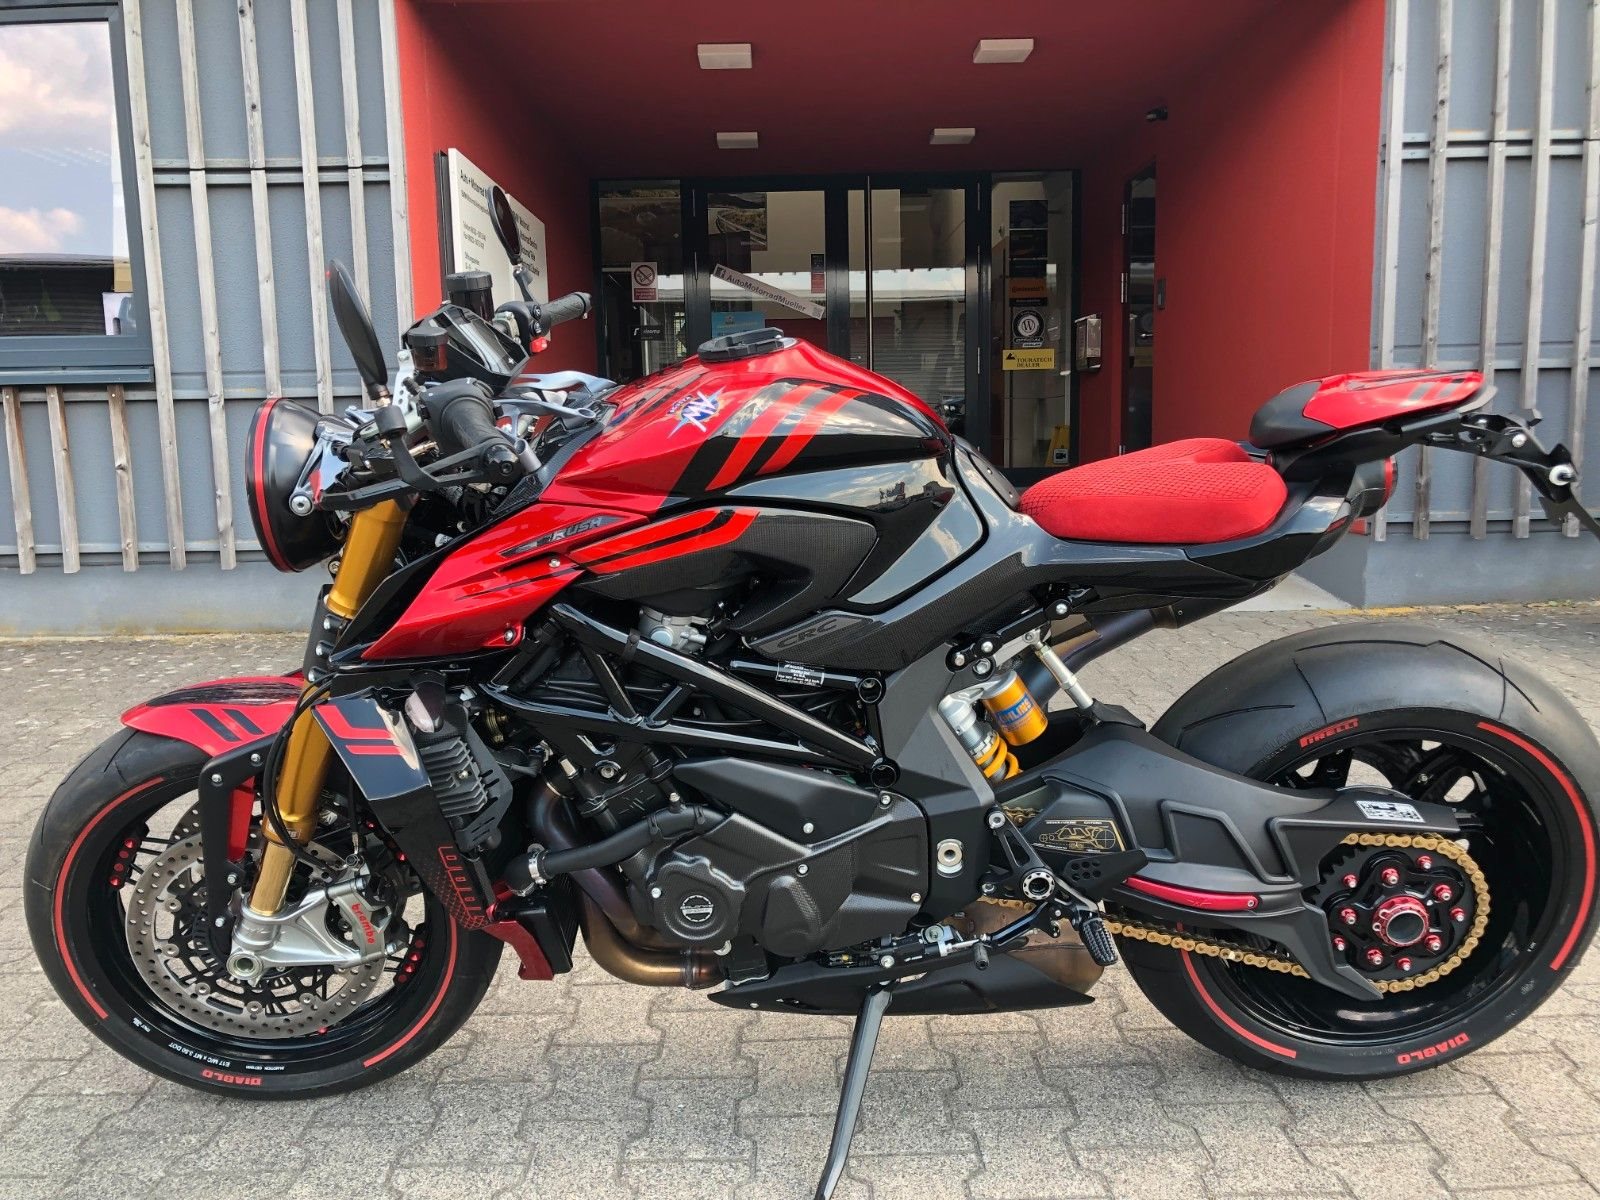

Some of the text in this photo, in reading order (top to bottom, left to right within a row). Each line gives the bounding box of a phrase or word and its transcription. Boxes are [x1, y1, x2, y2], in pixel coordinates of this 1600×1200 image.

[726, 274, 806, 313] AutoMotorradMueller
[776, 618, 838, 648] CRC
[1299, 718, 1359, 748] PIRELLI
[351, 903, 376, 944] brembo
[1397, 1032, 1470, 1064] DIABLO
[203, 1069, 261, 1086] DIABLO
